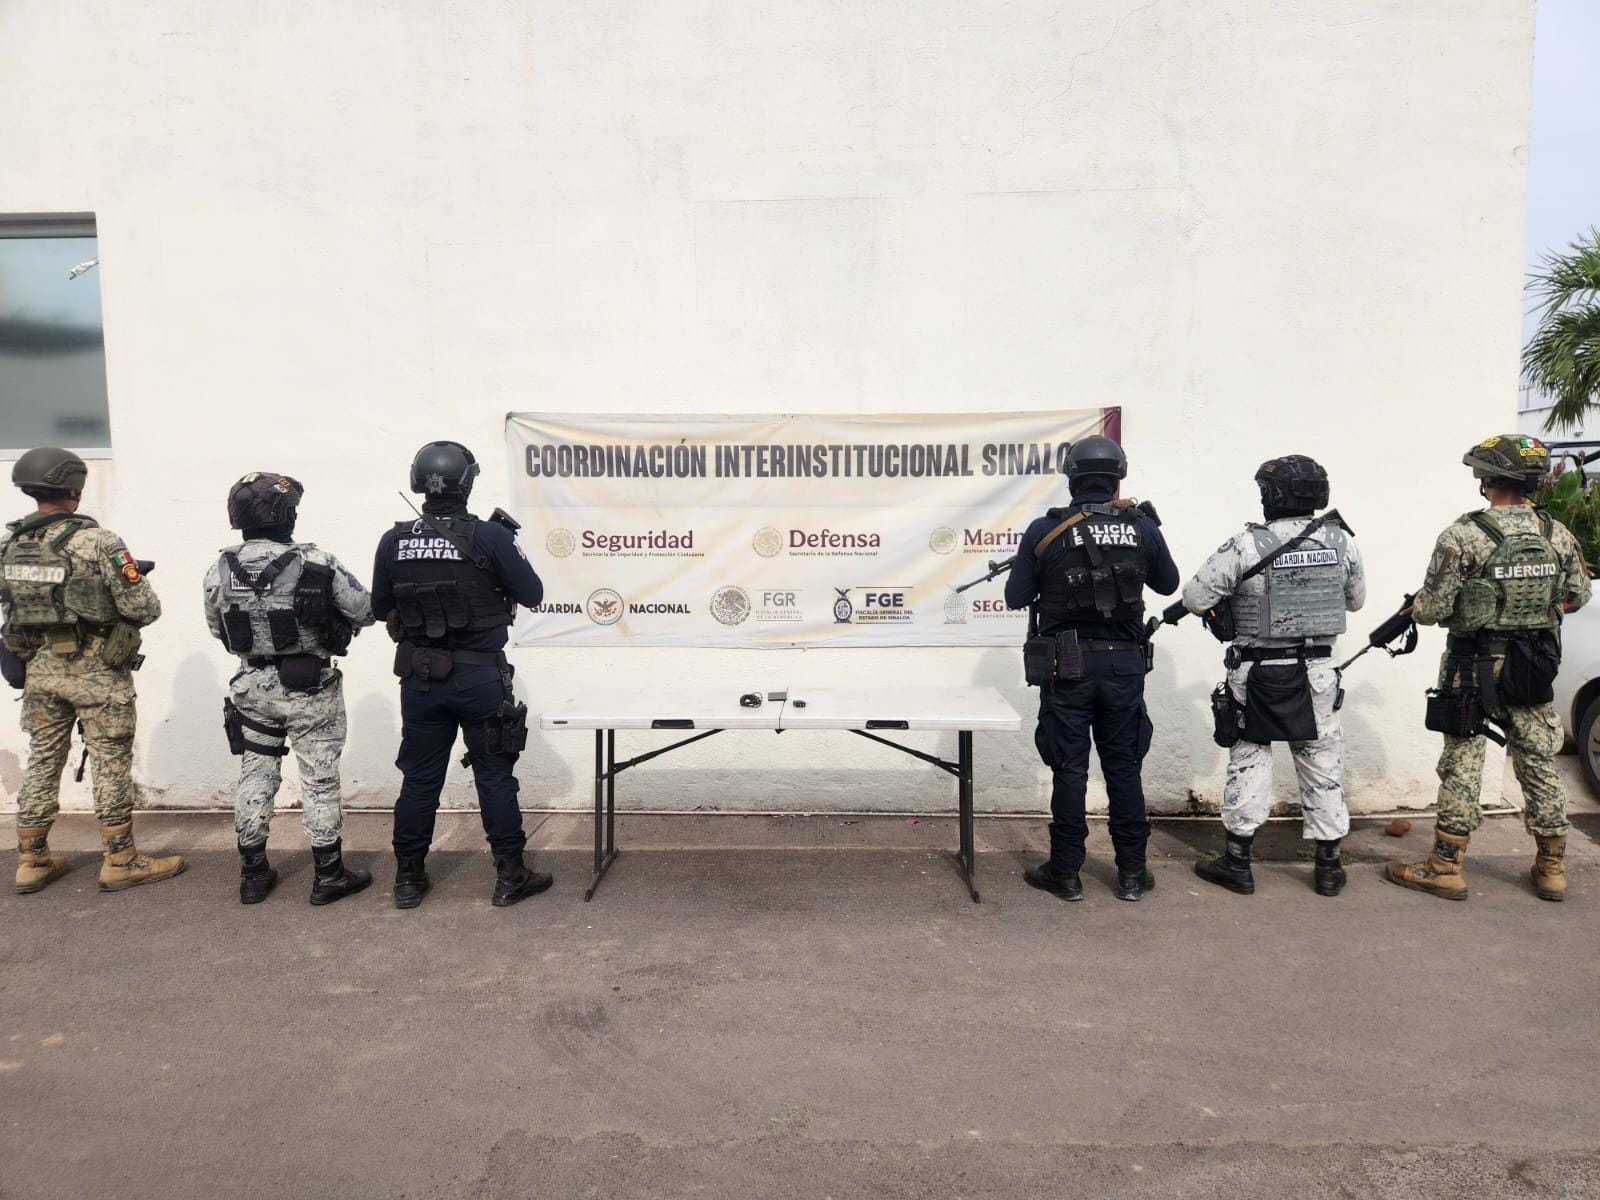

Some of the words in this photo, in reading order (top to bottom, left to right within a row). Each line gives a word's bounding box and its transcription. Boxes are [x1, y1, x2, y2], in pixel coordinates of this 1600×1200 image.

[525, 438, 706, 478] COORDINACIÓN
[715, 444, 974, 478] INTERINSTITUCIONAL
[981, 441, 1072, 476] SINALO
[398, 537, 456, 550] POLICI
[582, 530, 693, 552] Seguridad
[789, 529, 880, 548] Defensa
[964, 528, 1024, 546] Marin
[1074, 534, 1138, 546] ETATAL
[397, 548, 463, 561] ESTATAL
[1275, 553, 1305, 566] GUARDIA
[1306, 551, 1338, 564] NACIONAL
[1494, 562, 1557, 580] EJÉRCITO
[763, 592, 796, 607] FGR
[865, 593, 904, 608] FGE
[629, 603, 691, 614] NACIONAL
